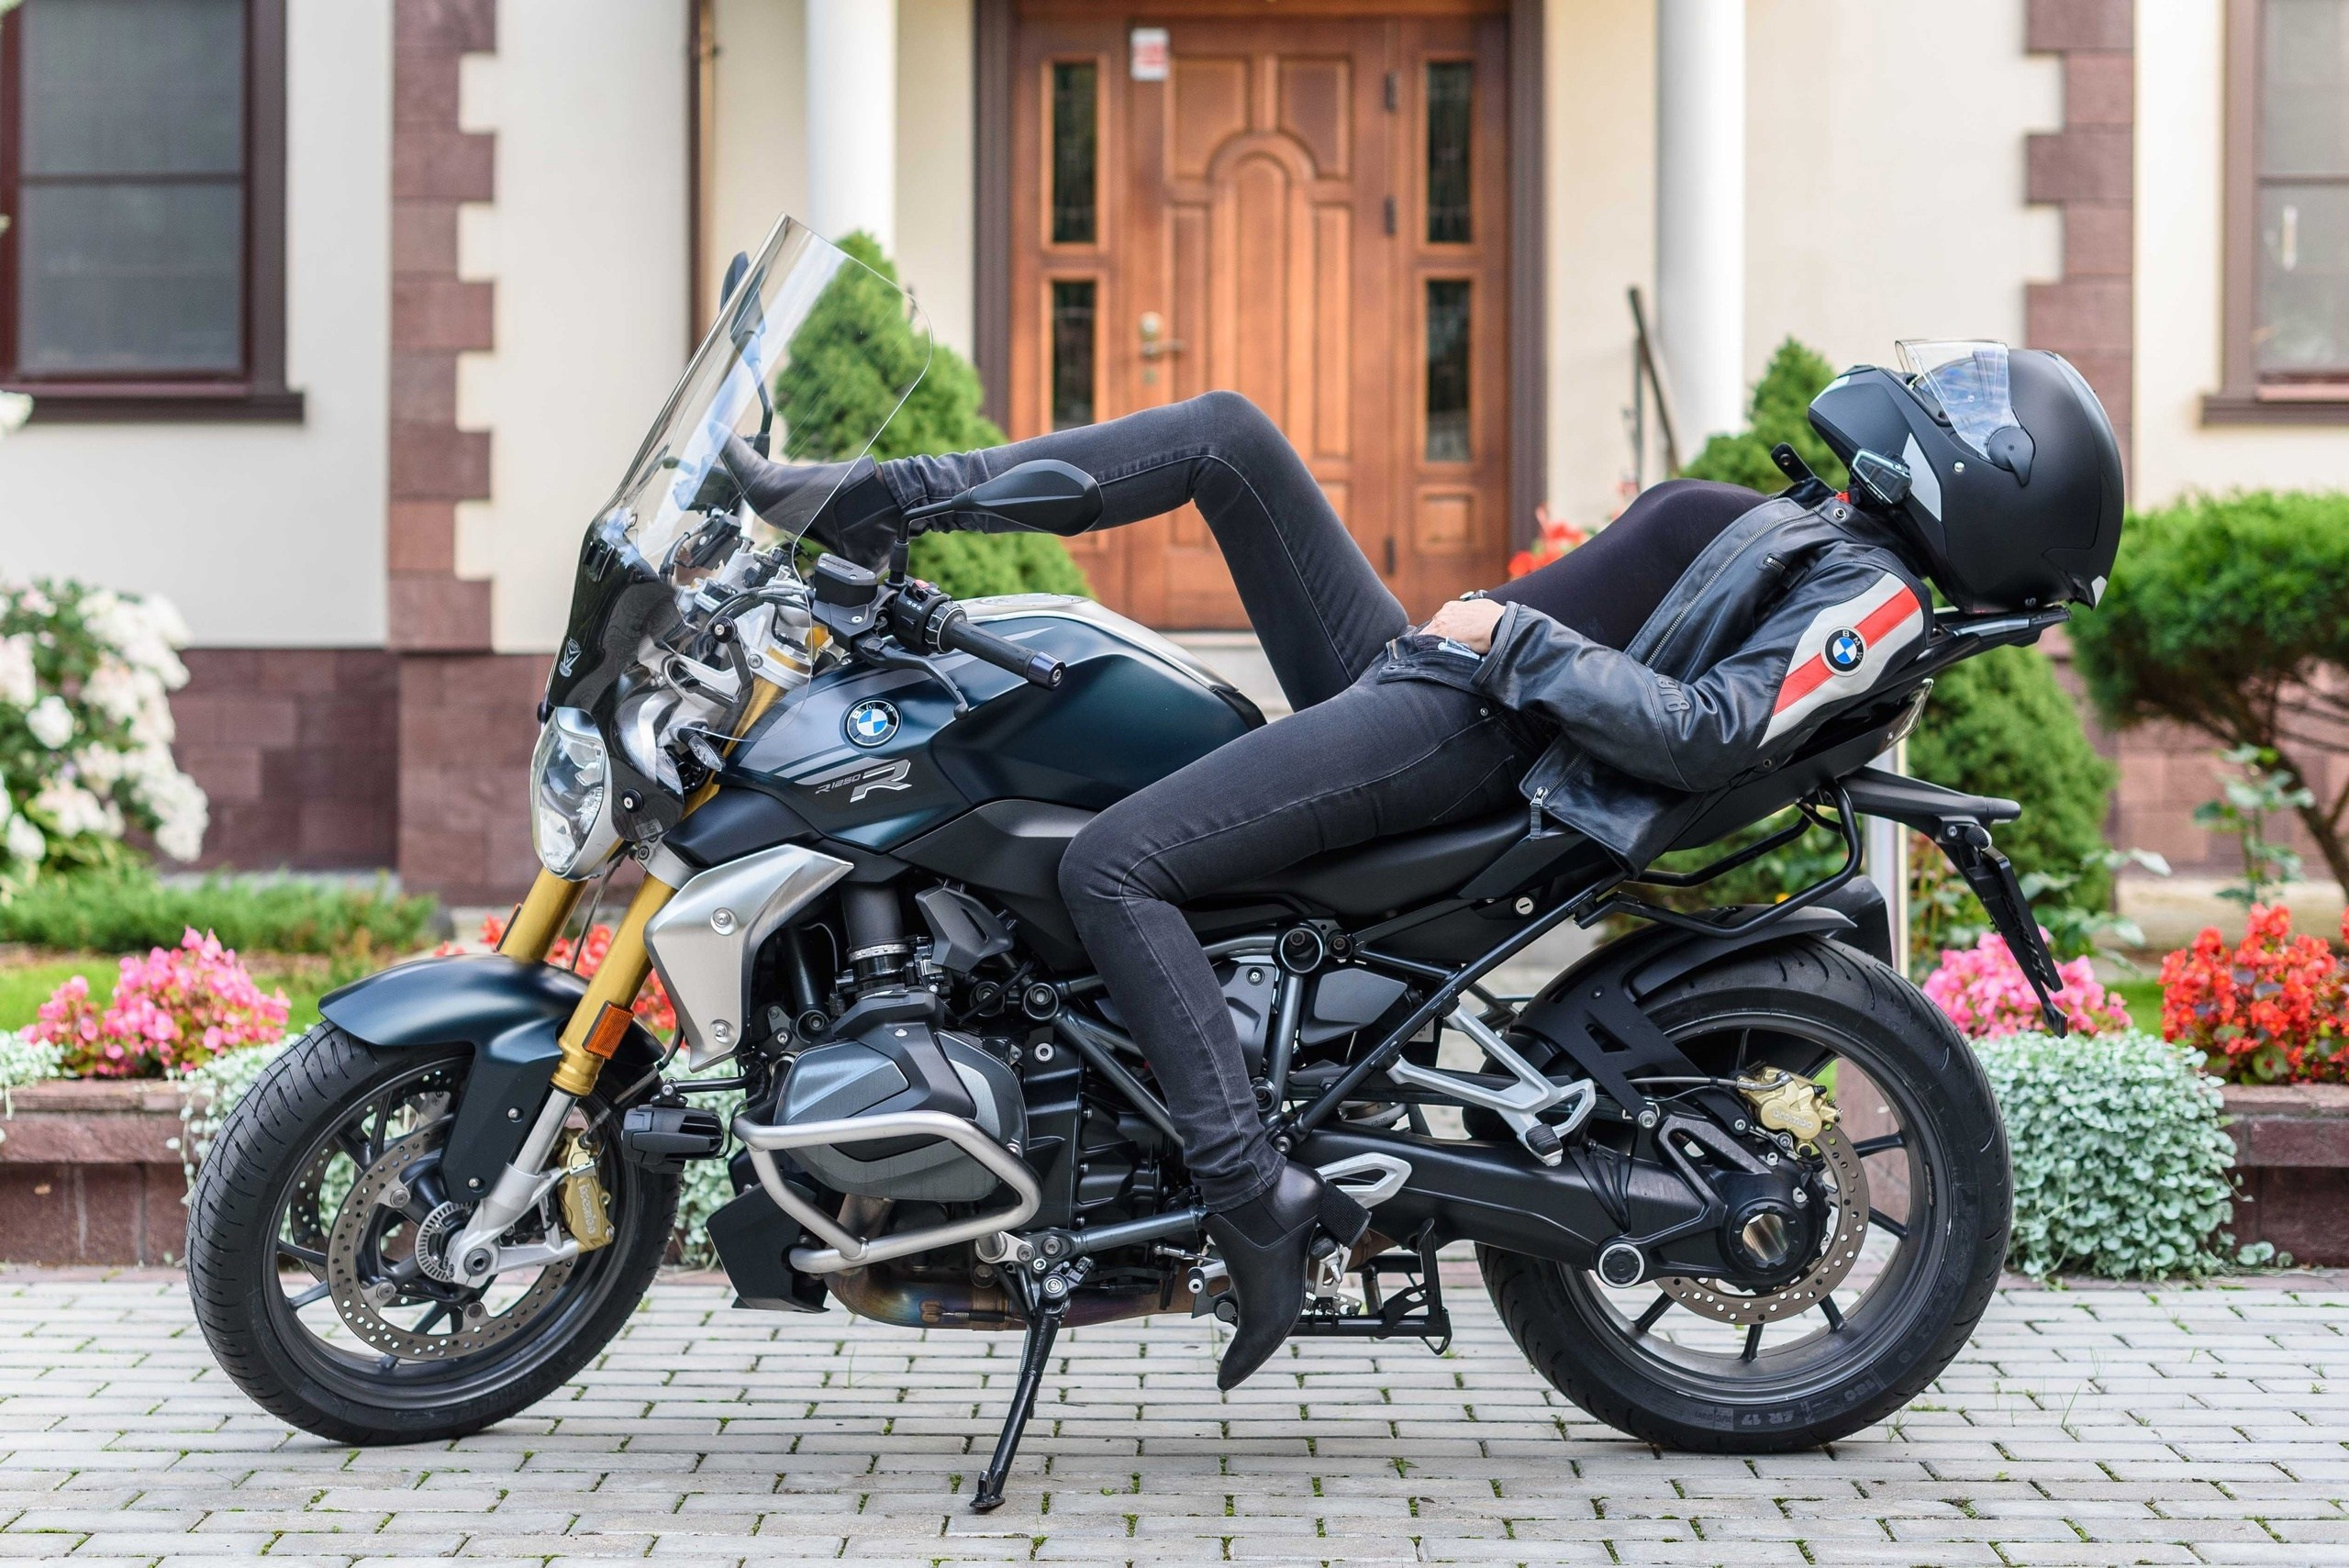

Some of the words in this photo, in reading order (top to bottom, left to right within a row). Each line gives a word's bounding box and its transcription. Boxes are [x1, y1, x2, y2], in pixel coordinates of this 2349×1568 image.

[1842, 629, 1864, 662] BMW
[851, 703, 897, 720] BMW
[1772, 1107, 1814, 1129] brembo
[579, 1183, 596, 1235] brembo
[1742, 1413, 1762, 1426] 17
